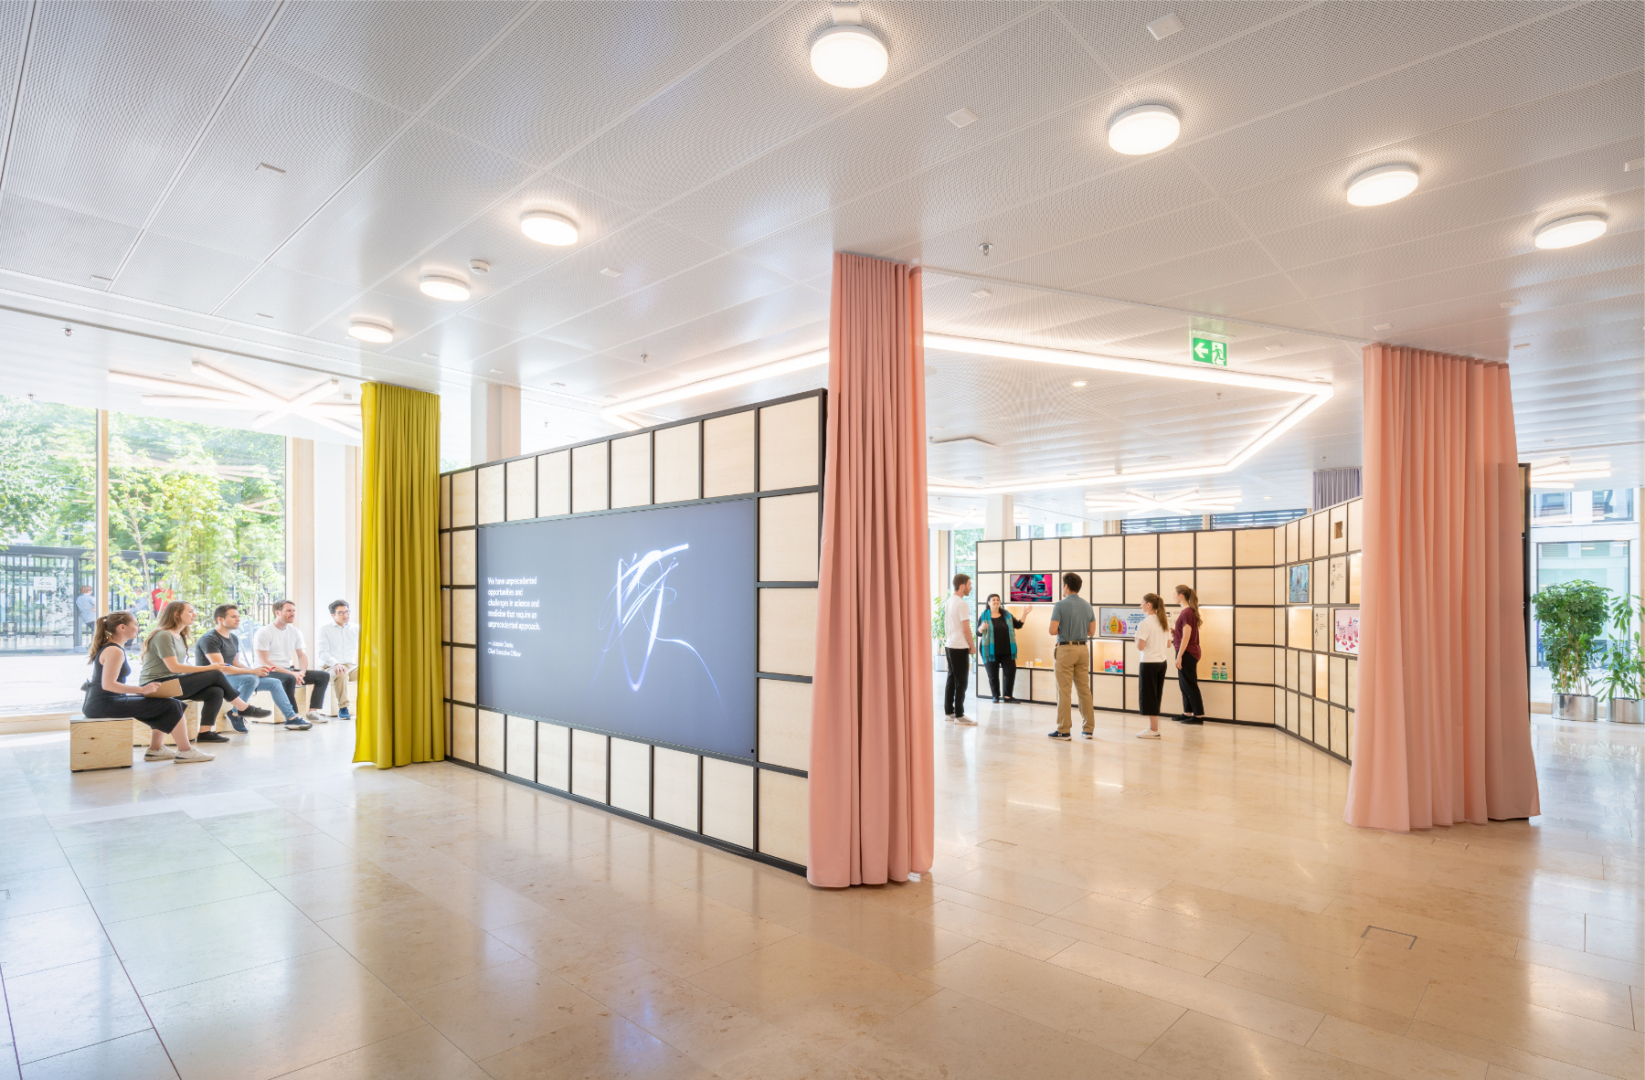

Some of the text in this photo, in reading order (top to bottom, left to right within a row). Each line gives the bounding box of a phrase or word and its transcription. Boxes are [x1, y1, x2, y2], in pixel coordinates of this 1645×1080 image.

[495, 577, 505, 585] have
[505, 577, 537, 586] unprecedented
[488, 588, 523, 597] opportunities and
[488, 598, 508, 608] challenges
[514, 599, 530, 607] science
[531, 599, 539, 607] and
[488, 609, 505, 617] medicine
[516, 611, 531, 620] require
[488, 620, 518, 629] unprecedented
